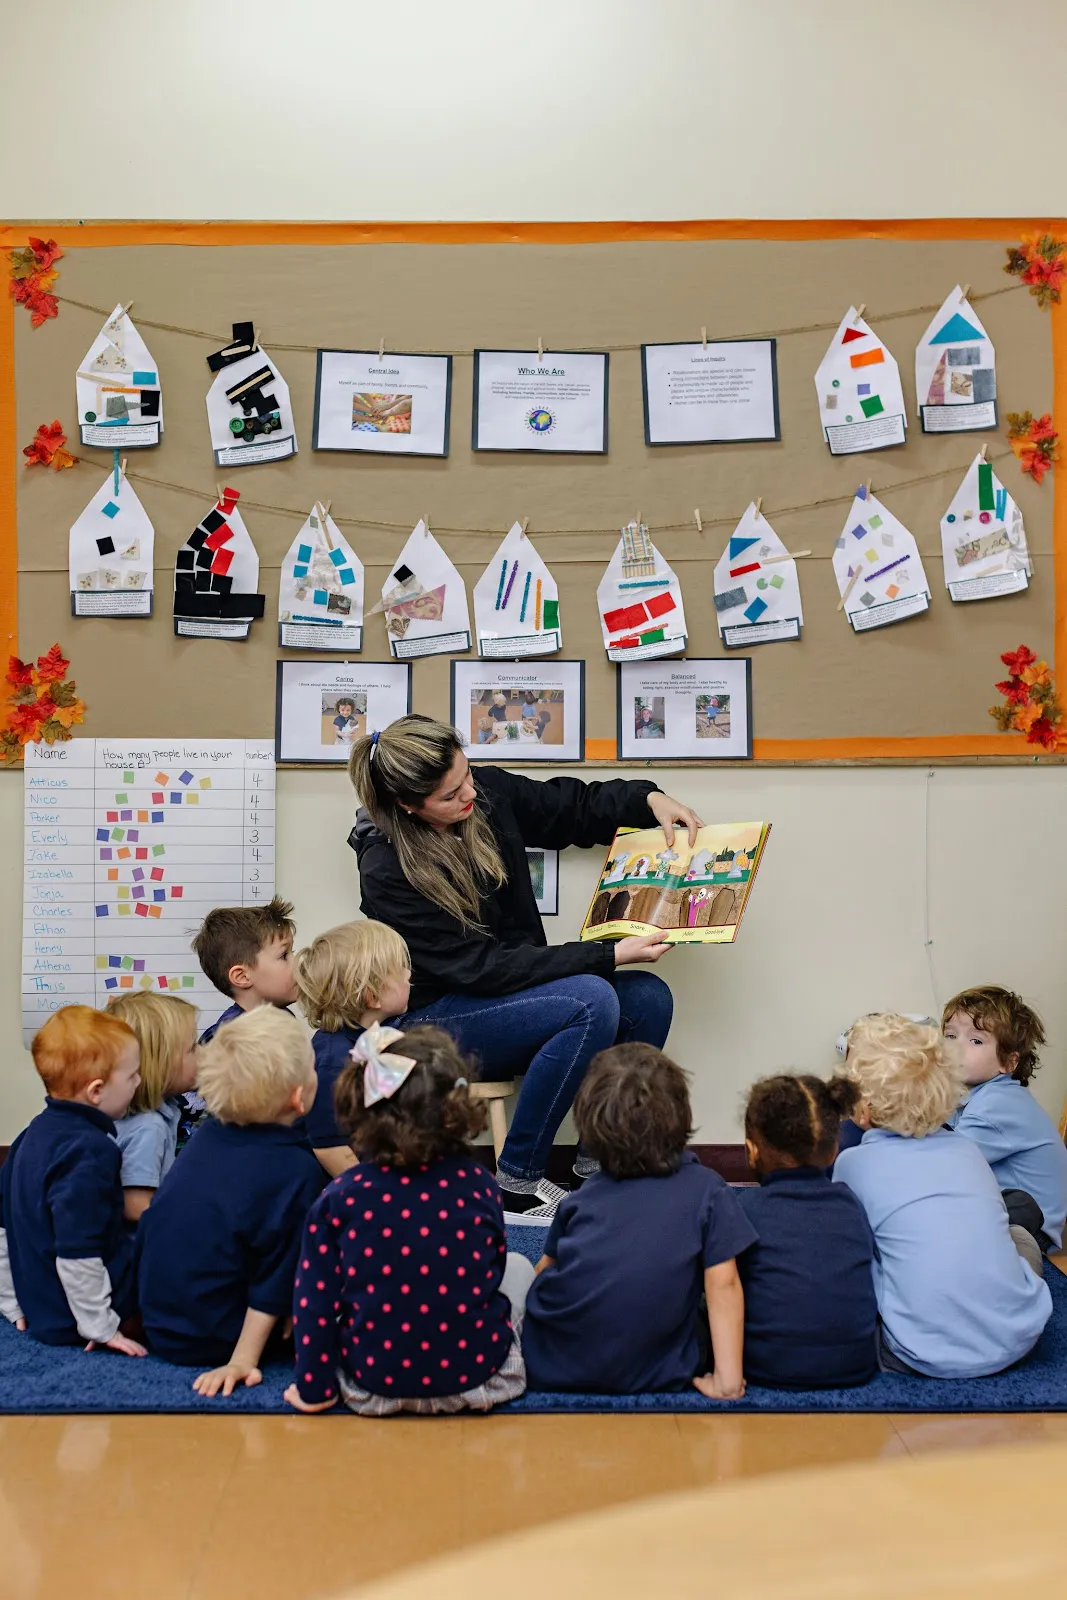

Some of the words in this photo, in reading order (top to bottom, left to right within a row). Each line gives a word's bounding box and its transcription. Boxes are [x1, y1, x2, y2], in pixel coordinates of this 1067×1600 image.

[33, 748, 68, 760] Name
[102, 748, 124, 760] How
[127, 752, 151, 765] many
[152, 749, 181, 762] people
[183, 747, 199, 759] live
[200, 749, 209, 759] in
[210, 751, 233, 762] your
[245, 750, 274, 760] number
[104, 761, 135, 769] house
[29, 777, 68, 787] Atticus
[252, 773, 264, 788] 4
[30, 794, 57, 805] Nico
[250, 794, 260, 808] 4
[29, 811, 60, 823] Parker
[250, 812, 260, 825] 4
[31, 828, 68, 847] Everly
[249, 829, 260, 844] 3
[26, 848, 59, 861] Jake
[252, 847, 262, 862] 4
[28, 869, 74, 879] Izabella
[249, 868, 260, 882] 3
[251, 885, 261, 898] 4
[32, 905, 73, 917] Charles
[33, 922, 66, 935] Ethan
[34, 941, 63, 956] Henry
[33, 959, 71, 971] Athena
